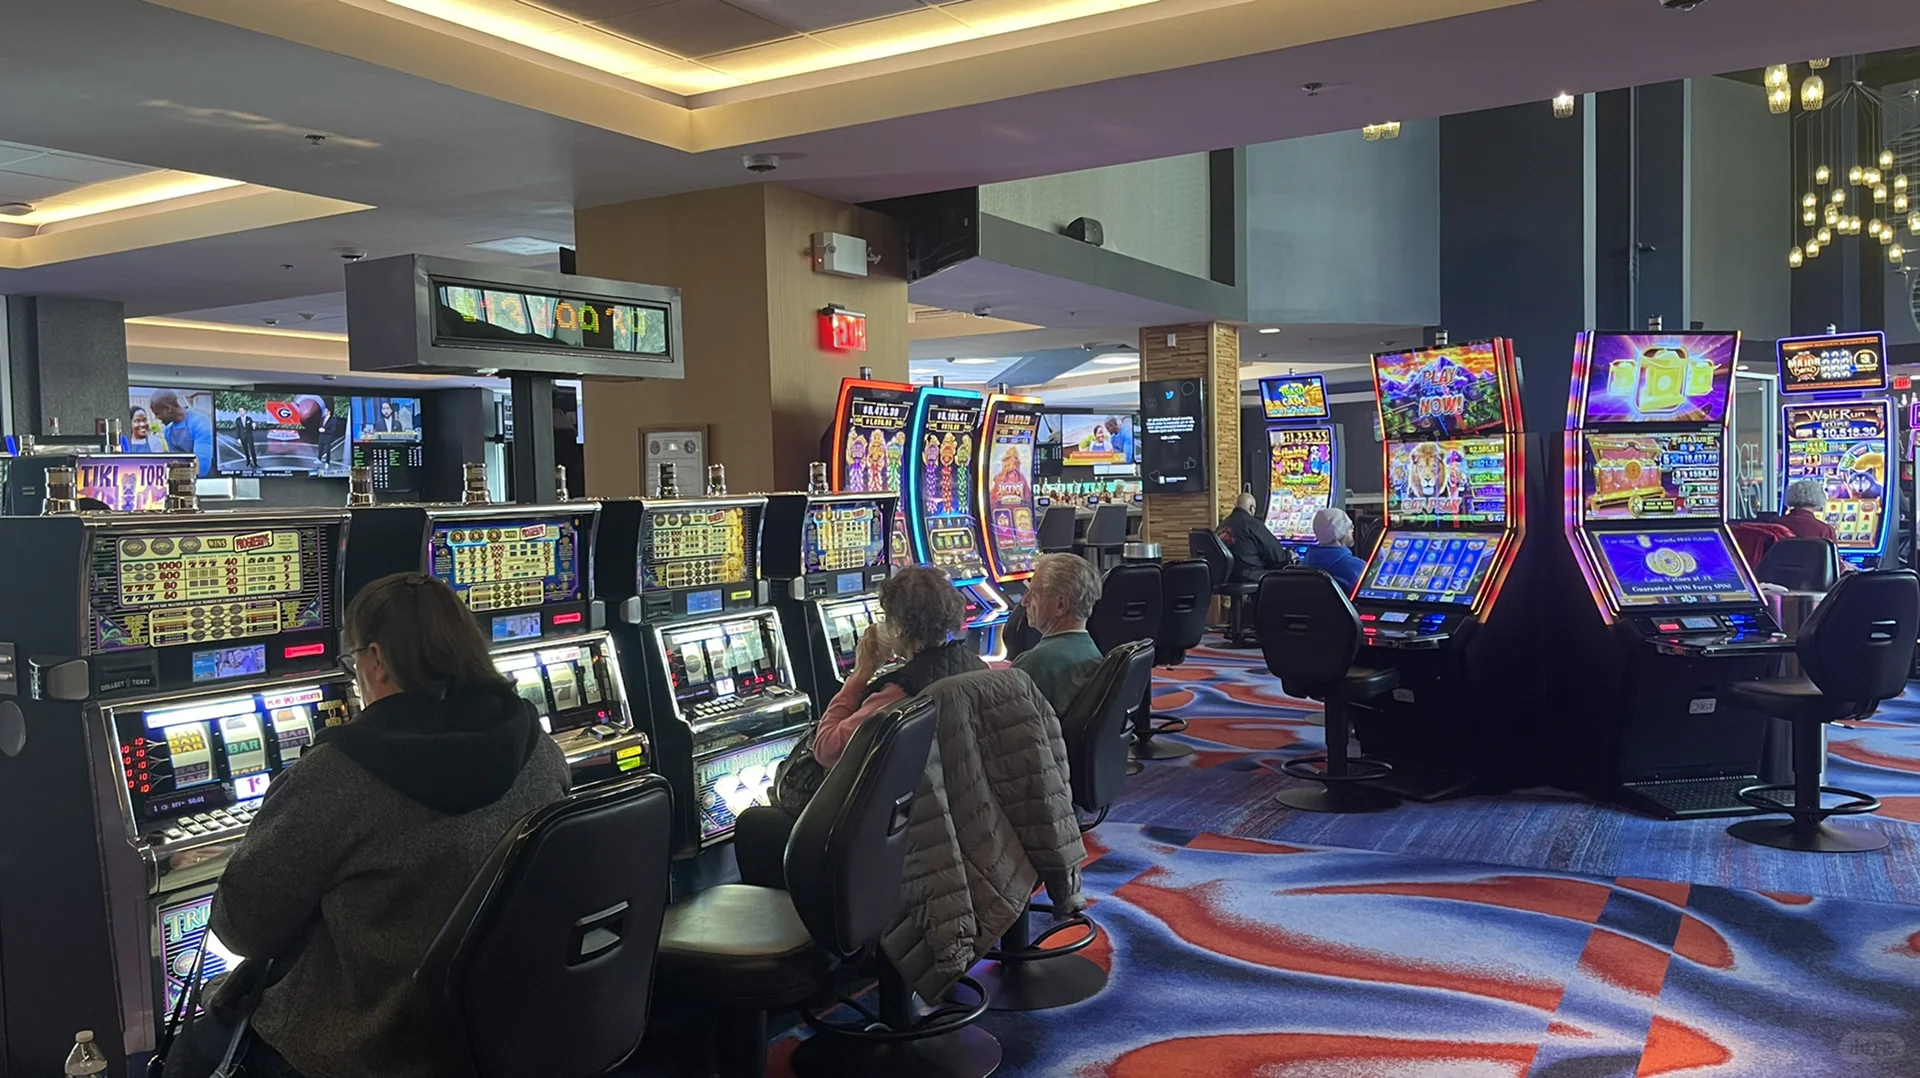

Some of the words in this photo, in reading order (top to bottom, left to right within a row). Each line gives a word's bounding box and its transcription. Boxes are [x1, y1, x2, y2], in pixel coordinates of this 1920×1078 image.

[1423, 367, 1457, 385] PLAY
[1420, 396, 1465, 416] NOW!
[1806, 410, 1840, 421] Wolf
[1840, 410, 1865, 418] Run
[1816, 427, 1877, 438] $10,518.30
[82, 464, 118, 487] TIKI
[140, 464, 164, 486] TOR
[156, 561, 182, 570] 1000
[224, 558, 238, 566] 40
[160, 571, 180, 580] 800
[164, 582, 178, 590] 80
[226, 578, 238, 586] 20
[164, 591, 178, 600] 60
[227, 586, 238, 594] 10
[100, 680, 124, 692] COLLECT
[132, 678, 150, 686] TICKET
[229, 739, 260, 754] BAR
[246, 777, 260, 792] 1¢
